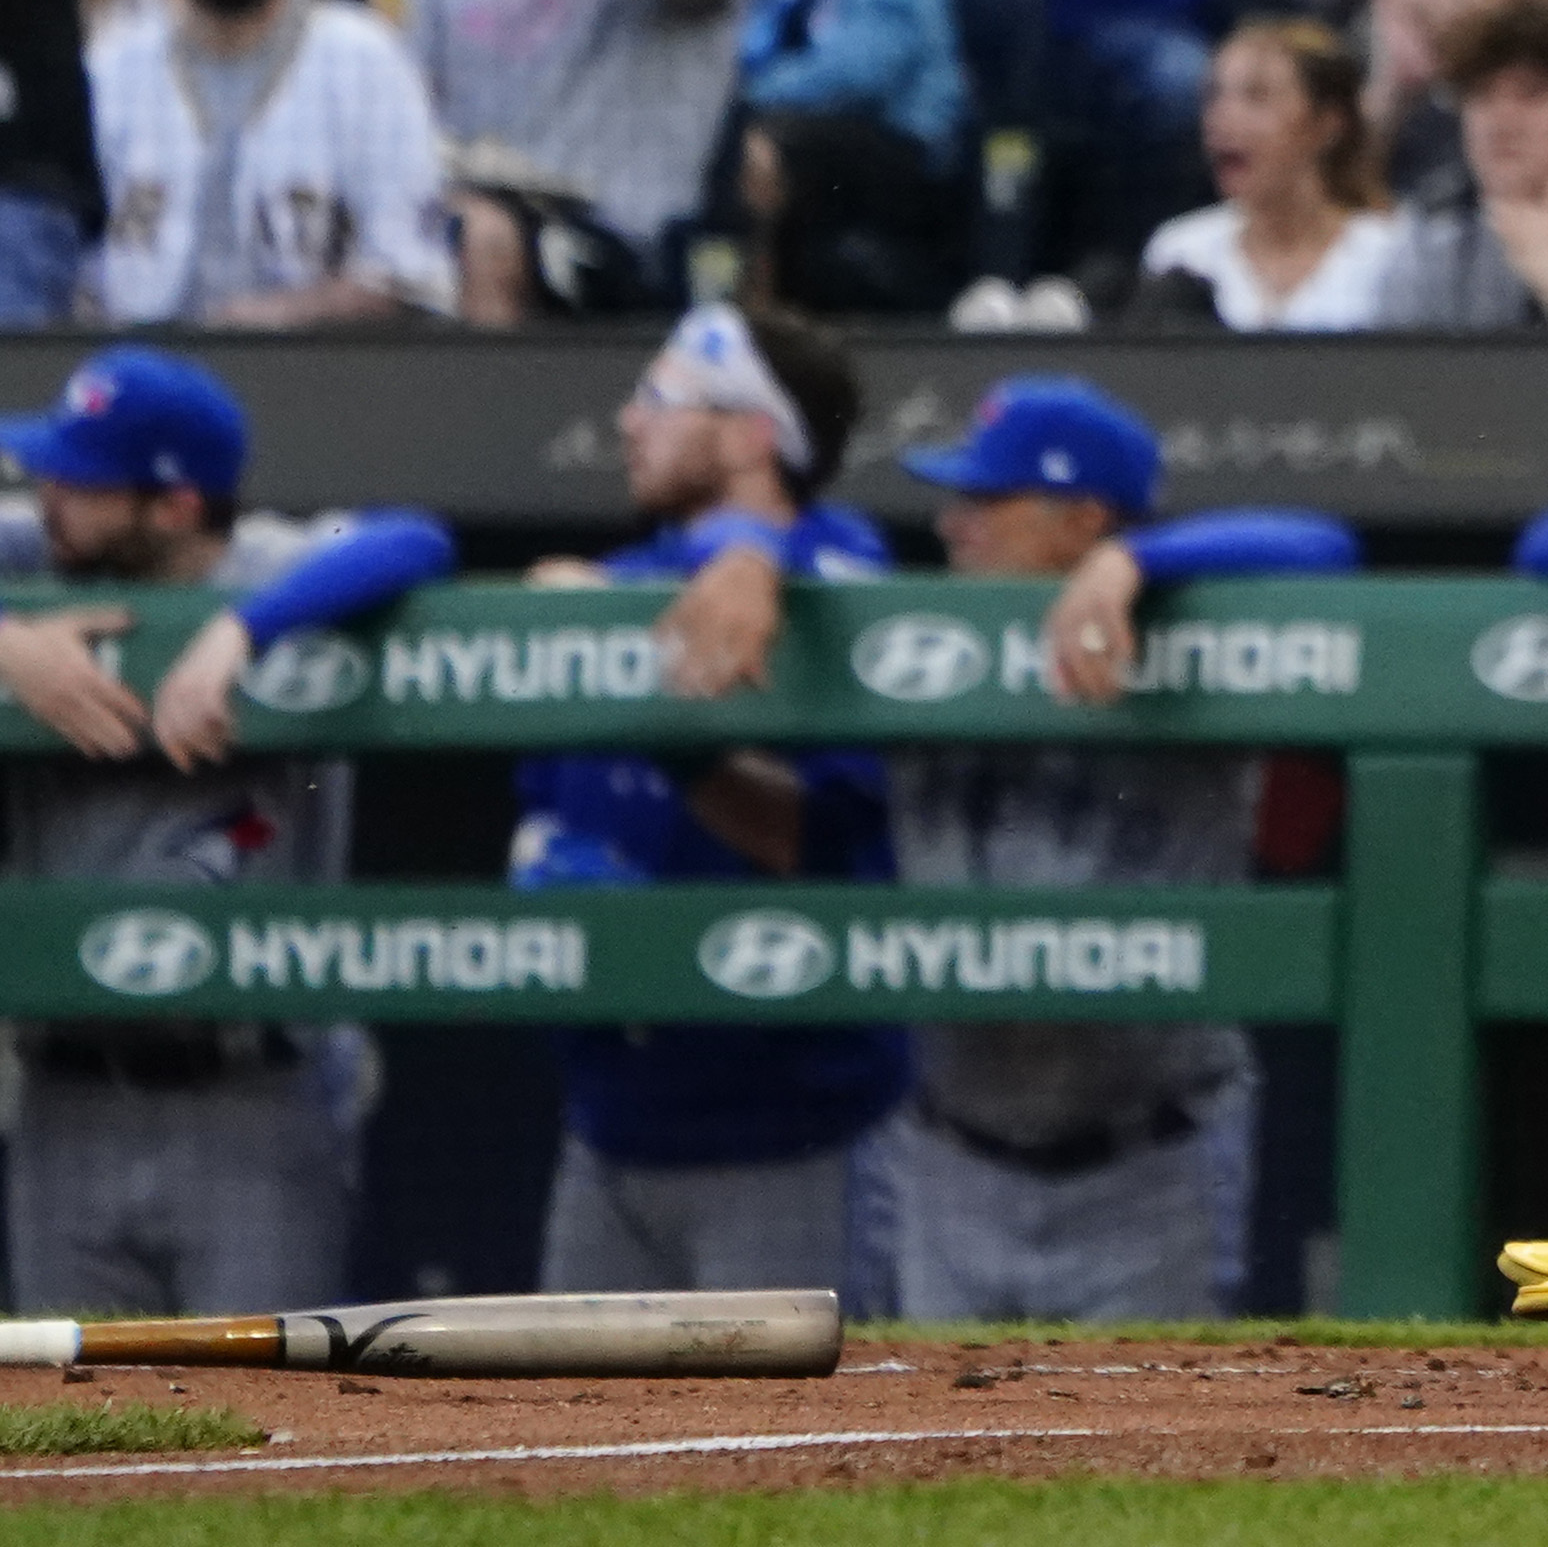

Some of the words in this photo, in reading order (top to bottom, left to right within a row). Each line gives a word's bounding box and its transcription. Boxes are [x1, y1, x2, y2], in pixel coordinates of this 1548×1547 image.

[382, 624, 664, 704] HYUND
[1000, 620, 1362, 696] HUNDAI
[227, 915, 588, 993] HYUNDAI
[845, 917, 1204, 995] HYUNDAI
